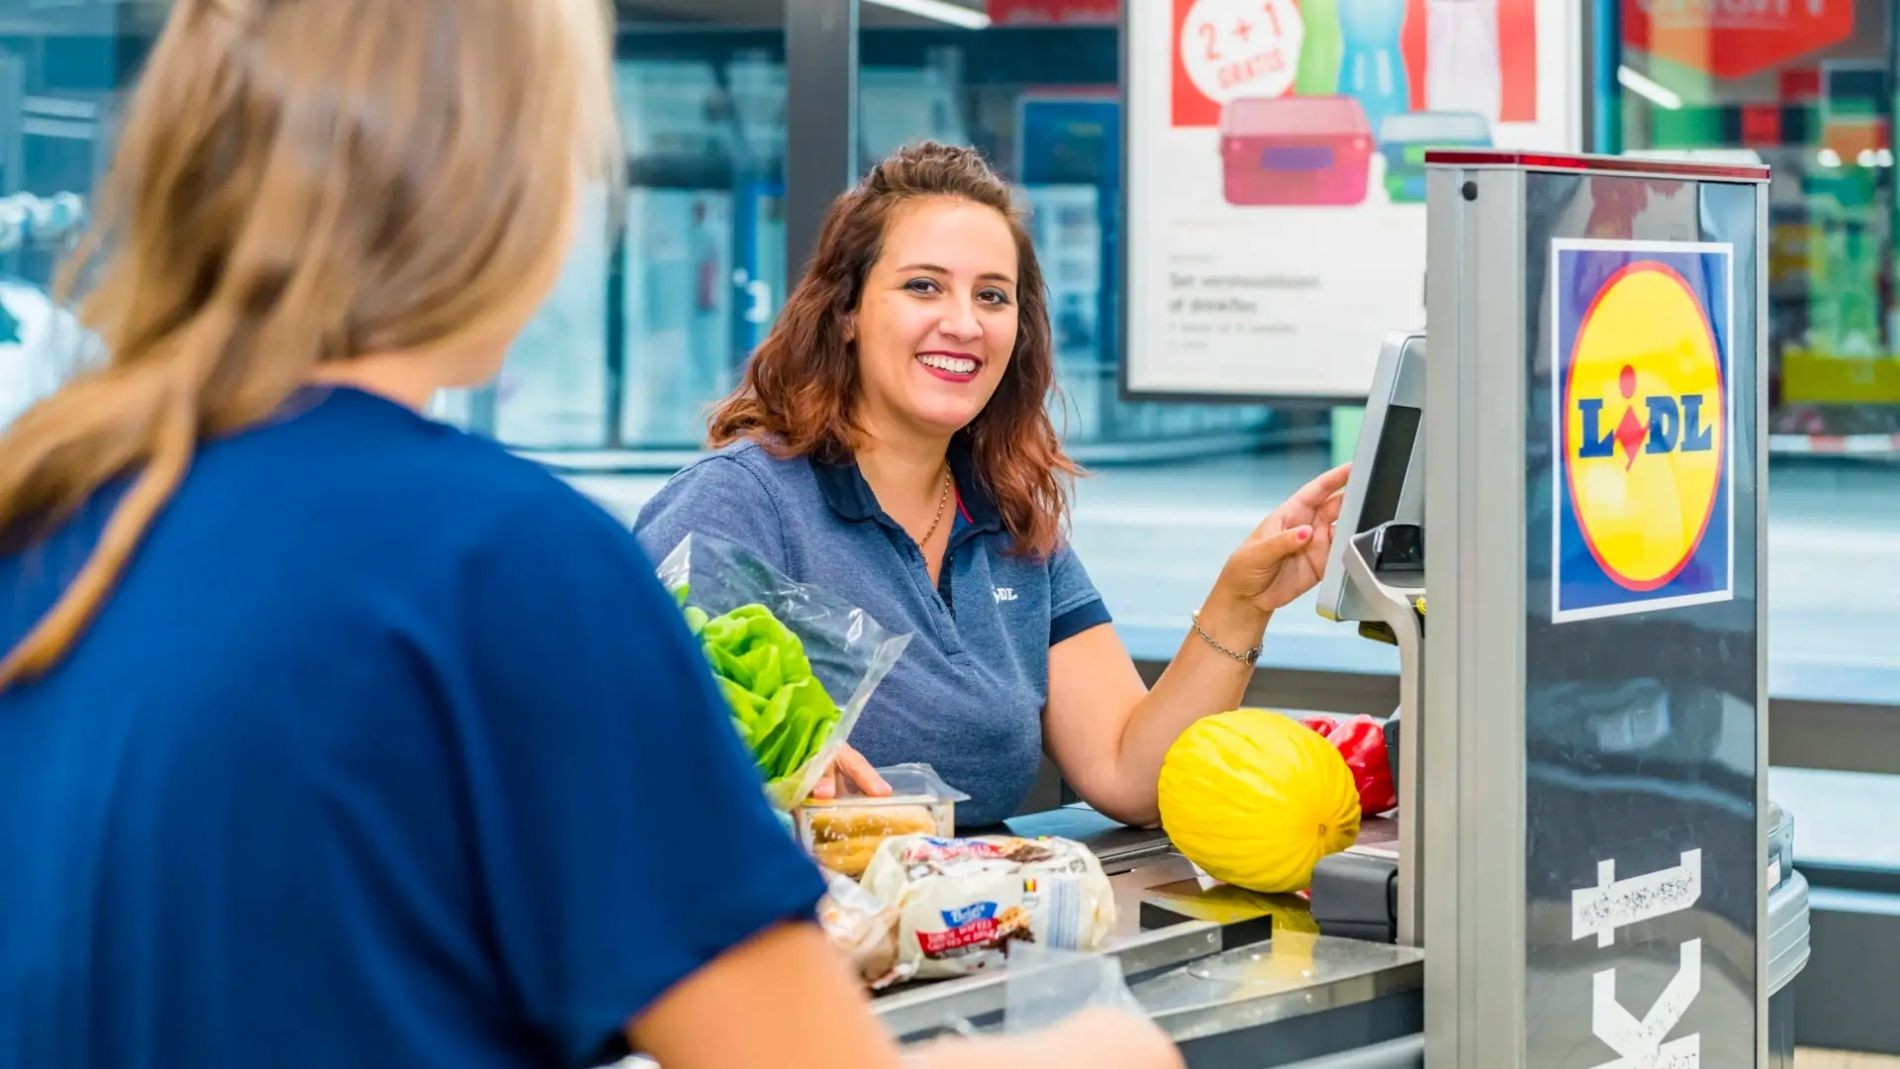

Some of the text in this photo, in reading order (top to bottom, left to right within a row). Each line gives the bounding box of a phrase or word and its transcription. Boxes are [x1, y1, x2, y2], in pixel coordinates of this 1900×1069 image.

[1198, 1, 1281, 61] 2 + 1
[1217, 48, 1285, 89] GRATIS
